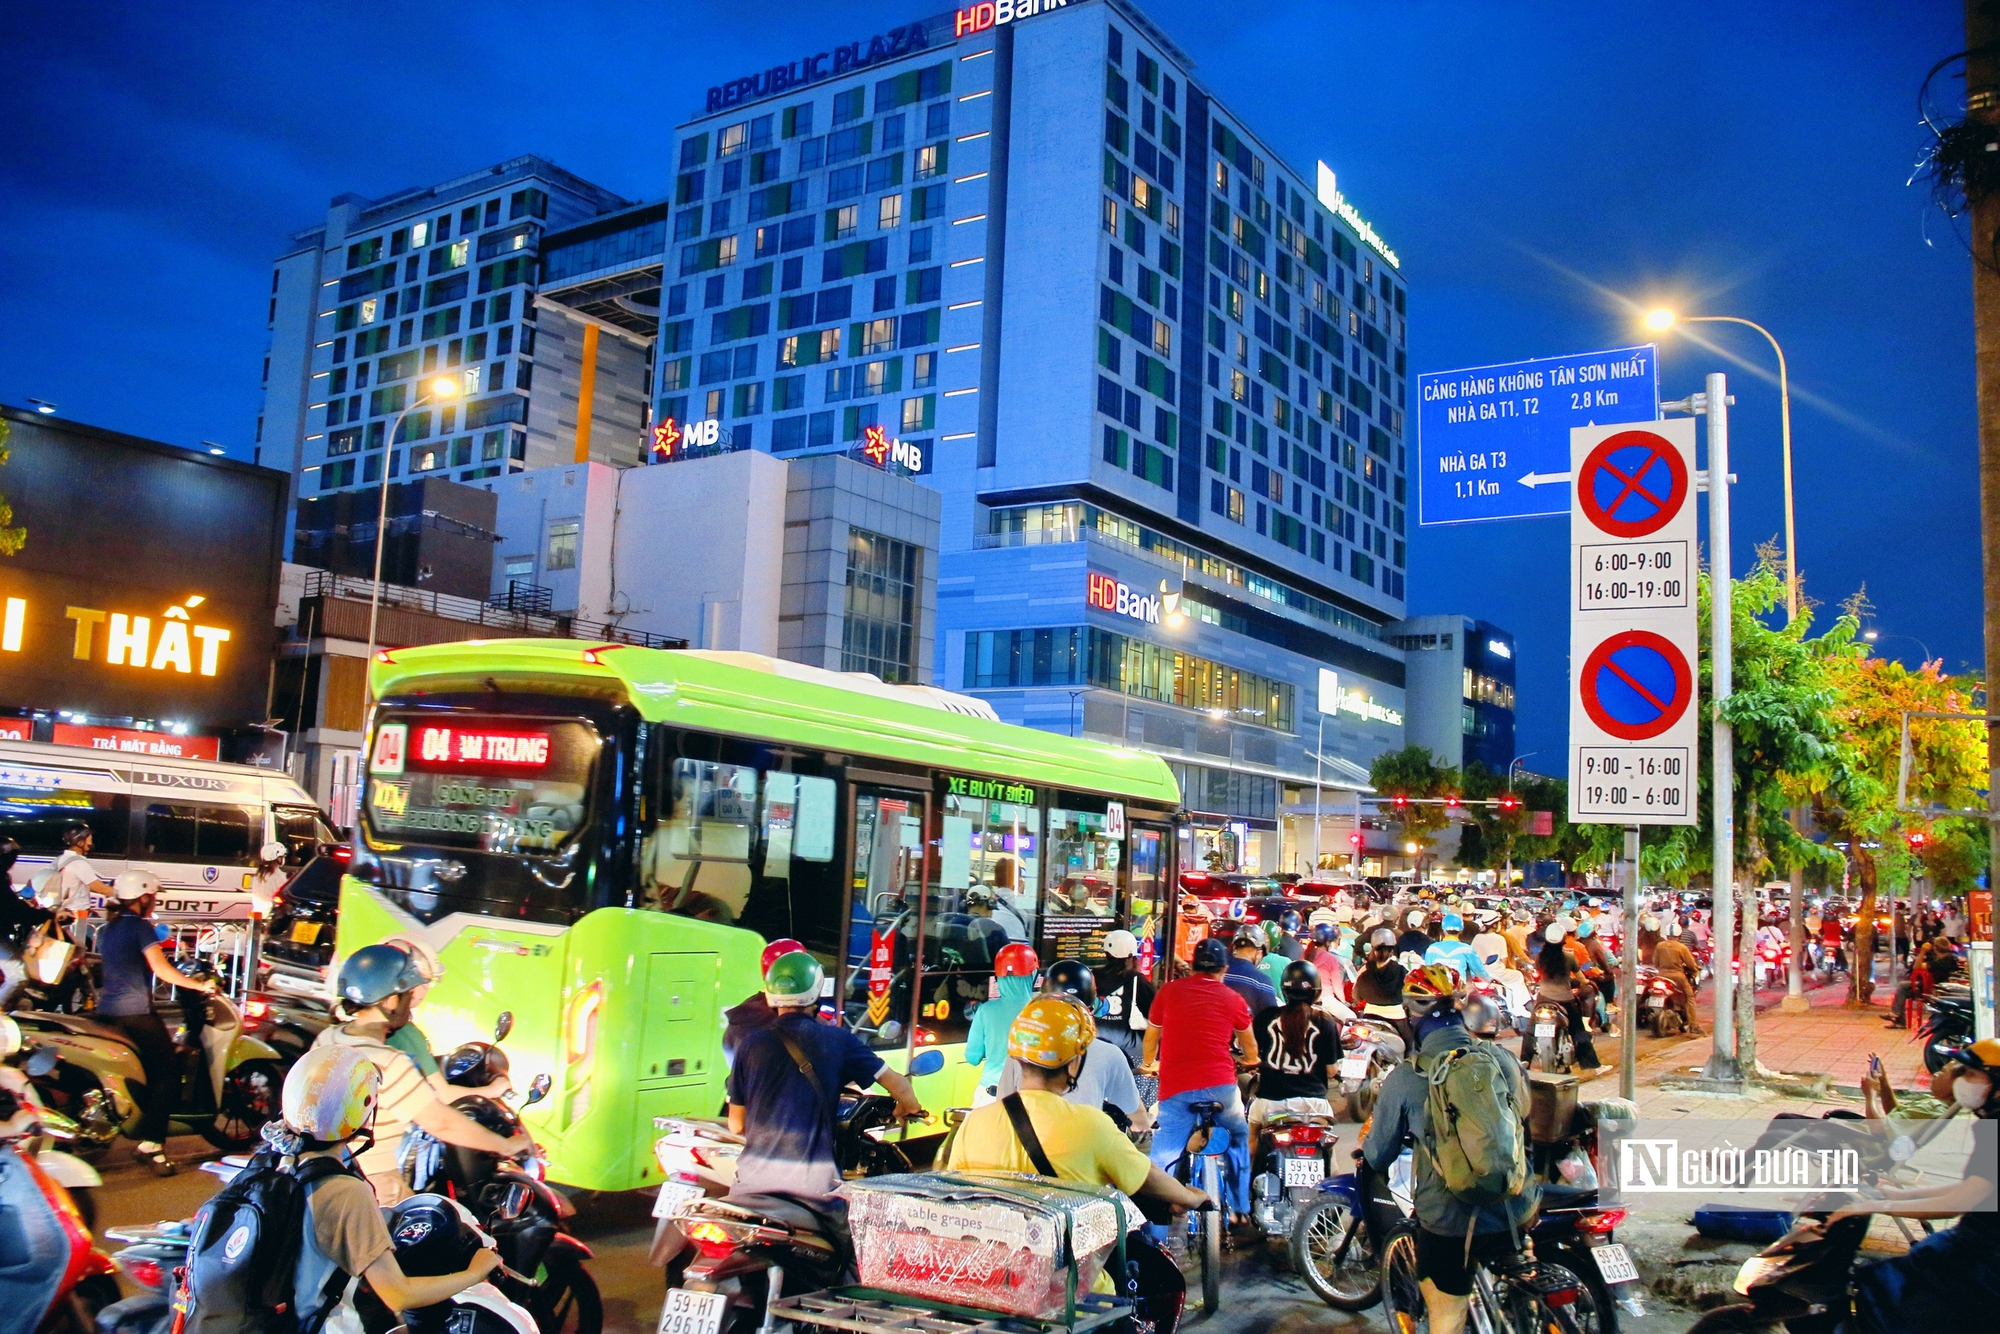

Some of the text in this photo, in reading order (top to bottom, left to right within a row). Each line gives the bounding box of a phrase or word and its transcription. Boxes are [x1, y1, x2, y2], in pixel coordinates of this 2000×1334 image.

[706, 22, 928, 113] REPUBLIC PLAZA
[1424, 352, 1647, 402] CẢNG HÀNG KHÔNG TÂN SƠN NHẤT
[1448, 397, 1540, 424] NHÀ GA T1, T2
[1570, 389, 1619, 411] 2,8 Km
[682, 419, 719, 449] MB
[891, 438, 922, 472] MB
[1439, 450, 1507, 473] NHÀ GA T3
[1455, 478, 1500, 498] 1,1 Km
[1595, 551, 1672, 572] 6:00-9:00
[1088, 572, 1160, 624] HDBank
[1586, 580, 1680, 600] 16:00-19:00
[66, 595, 231, 677] THẤT
[92, 735, 117, 750] TRẢ
[150, 739, 182, 756] BẰNG
[379, 733, 399, 765] 04
[421, 728, 451, 761] 04
[486, 736, 548, 763] TRUNG
[1586, 757, 1619, 775] 9:00
[1639, 757, 1680, 775] 16:00
[142, 772, 234, 791] LUXURY
[948, 777, 967, 796] XE
[969, 780, 1005, 800] BUÝT
[1586, 787, 1627, 804] 19:00
[1646, 787, 1680, 805] 6:00
[1109, 808, 1122, 834] 04
[155, 899, 219, 912] PORT
[1290, 1160, 1319, 1173] 59-V3
[1373, 1197, 1397, 1206] HONDA
[907, 1206, 983, 1230] table grapes
[1603, 1262, 1633, 1279] 403.37
[673, 1293, 715, 1317] 59-H1
